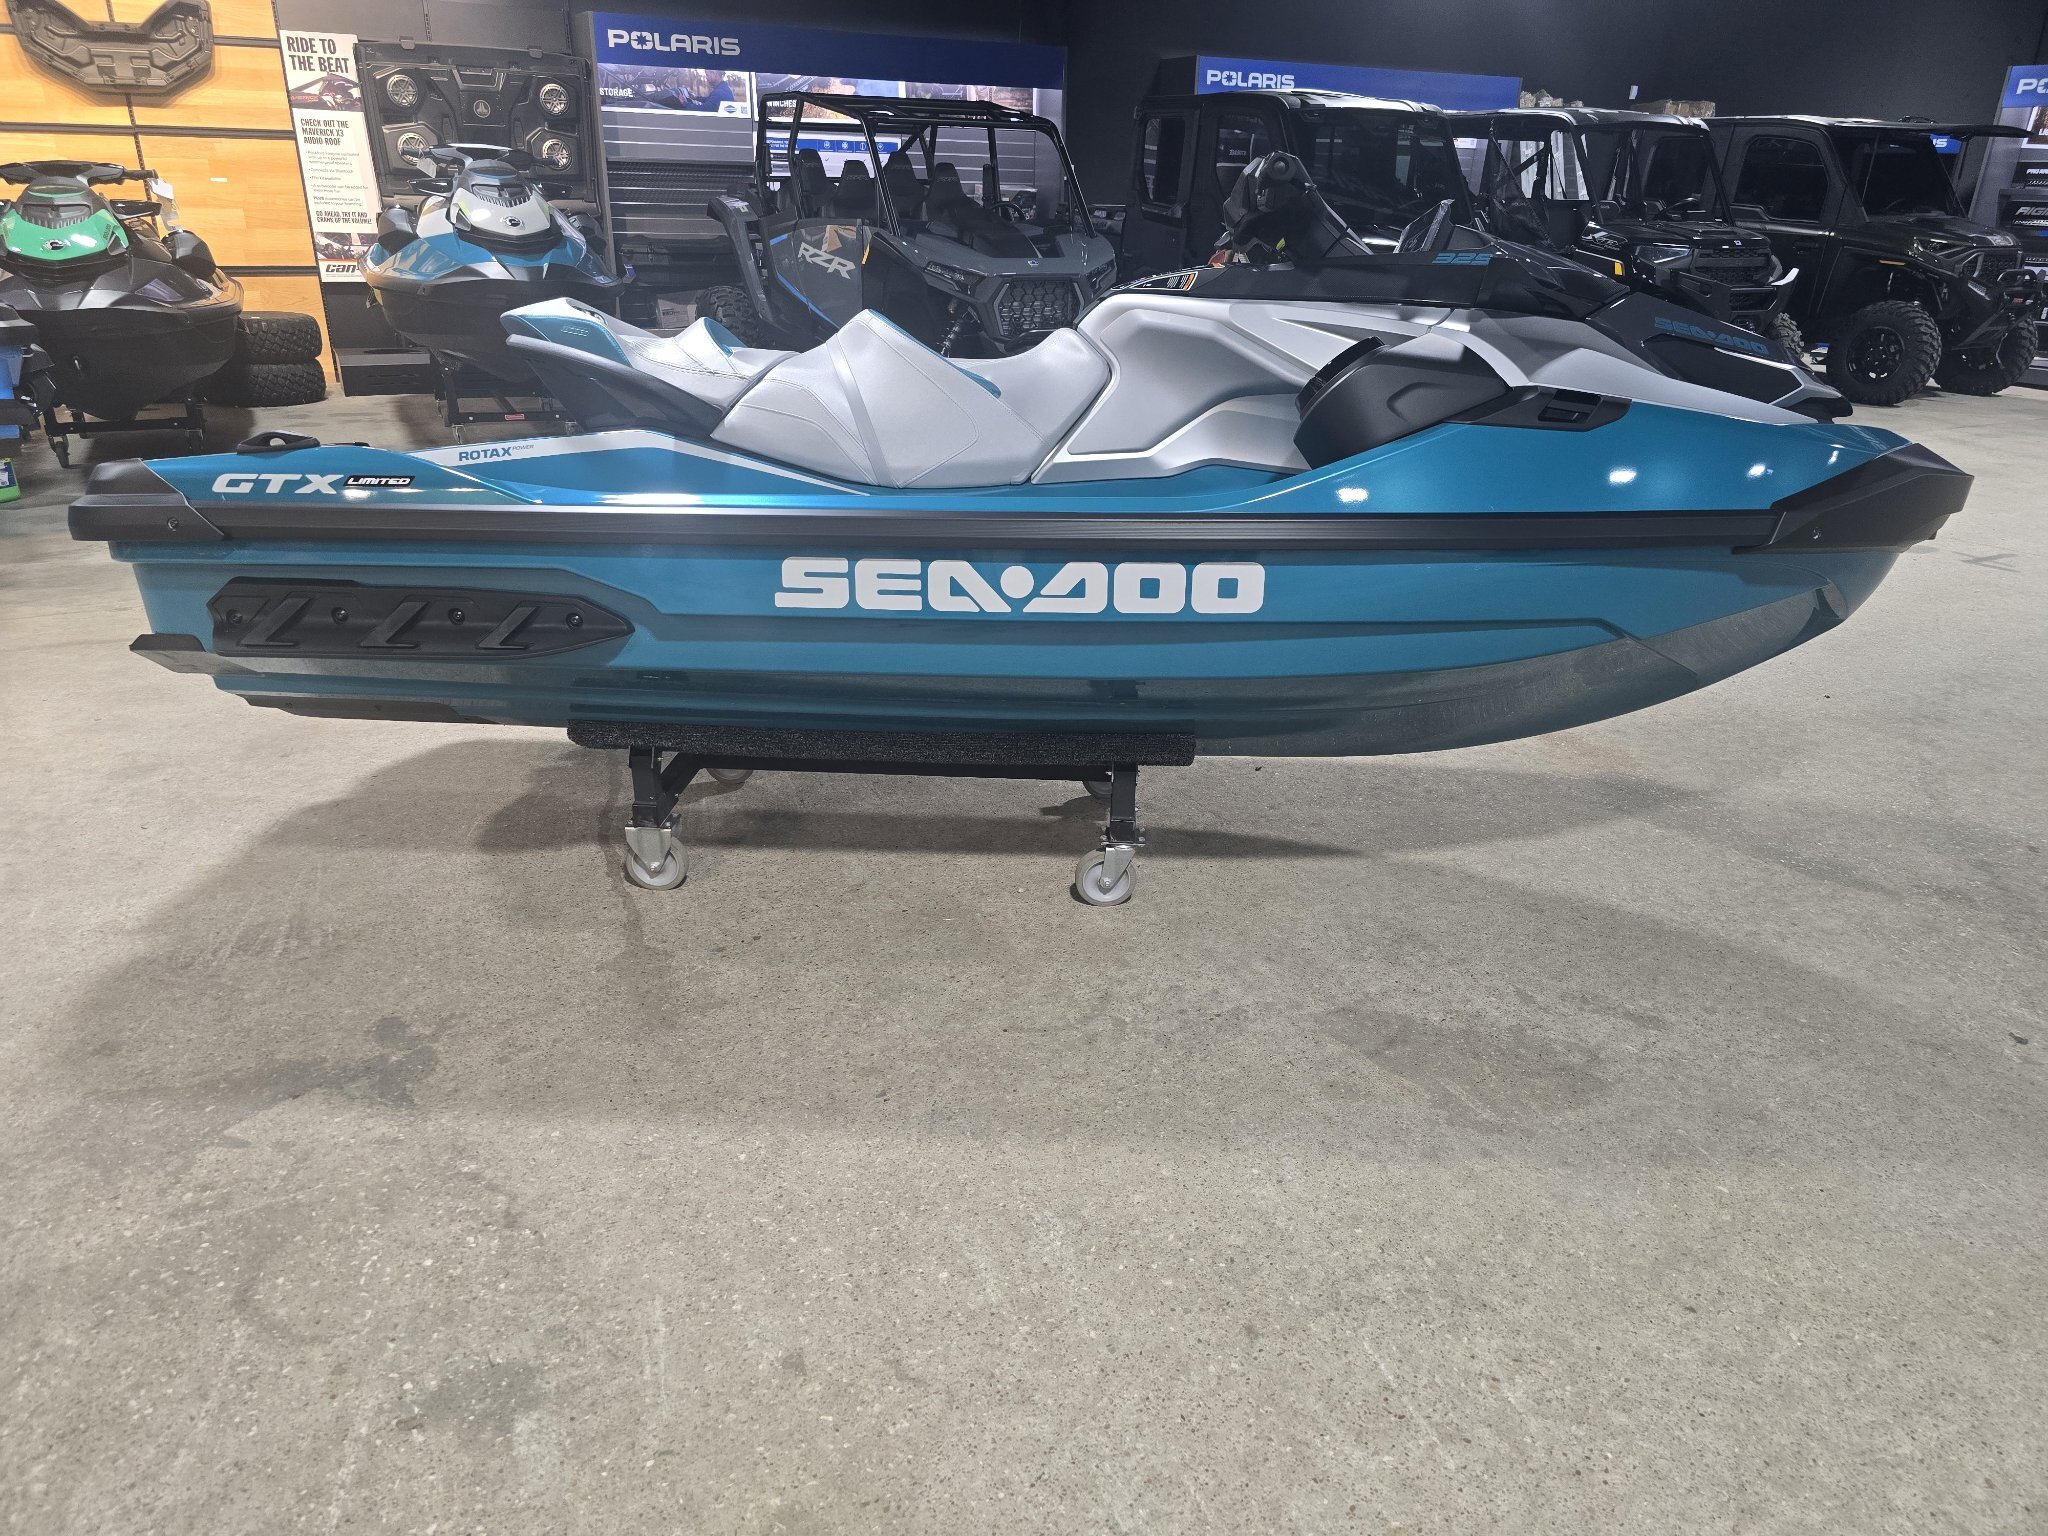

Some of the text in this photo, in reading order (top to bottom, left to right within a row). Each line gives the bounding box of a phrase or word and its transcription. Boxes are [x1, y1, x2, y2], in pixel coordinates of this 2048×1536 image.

[286, 36, 337, 54] RIDE TO
[607, 28, 741, 56] POLARIS
[289, 55, 350, 74] THE BEAT
[1206, 69, 1295, 89] POLARIS
[599, 86, 634, 98] STORAGE
[300, 118, 350, 129] CHECK OUT THE
[301, 127, 345, 138] MAVERICK X3
[303, 136, 341, 146] AUDIO ROOF
[797, 241, 856, 279] RZR
[458, 446, 512, 462] ROTAX
[211, 473, 411, 494] GTX LIMITED
